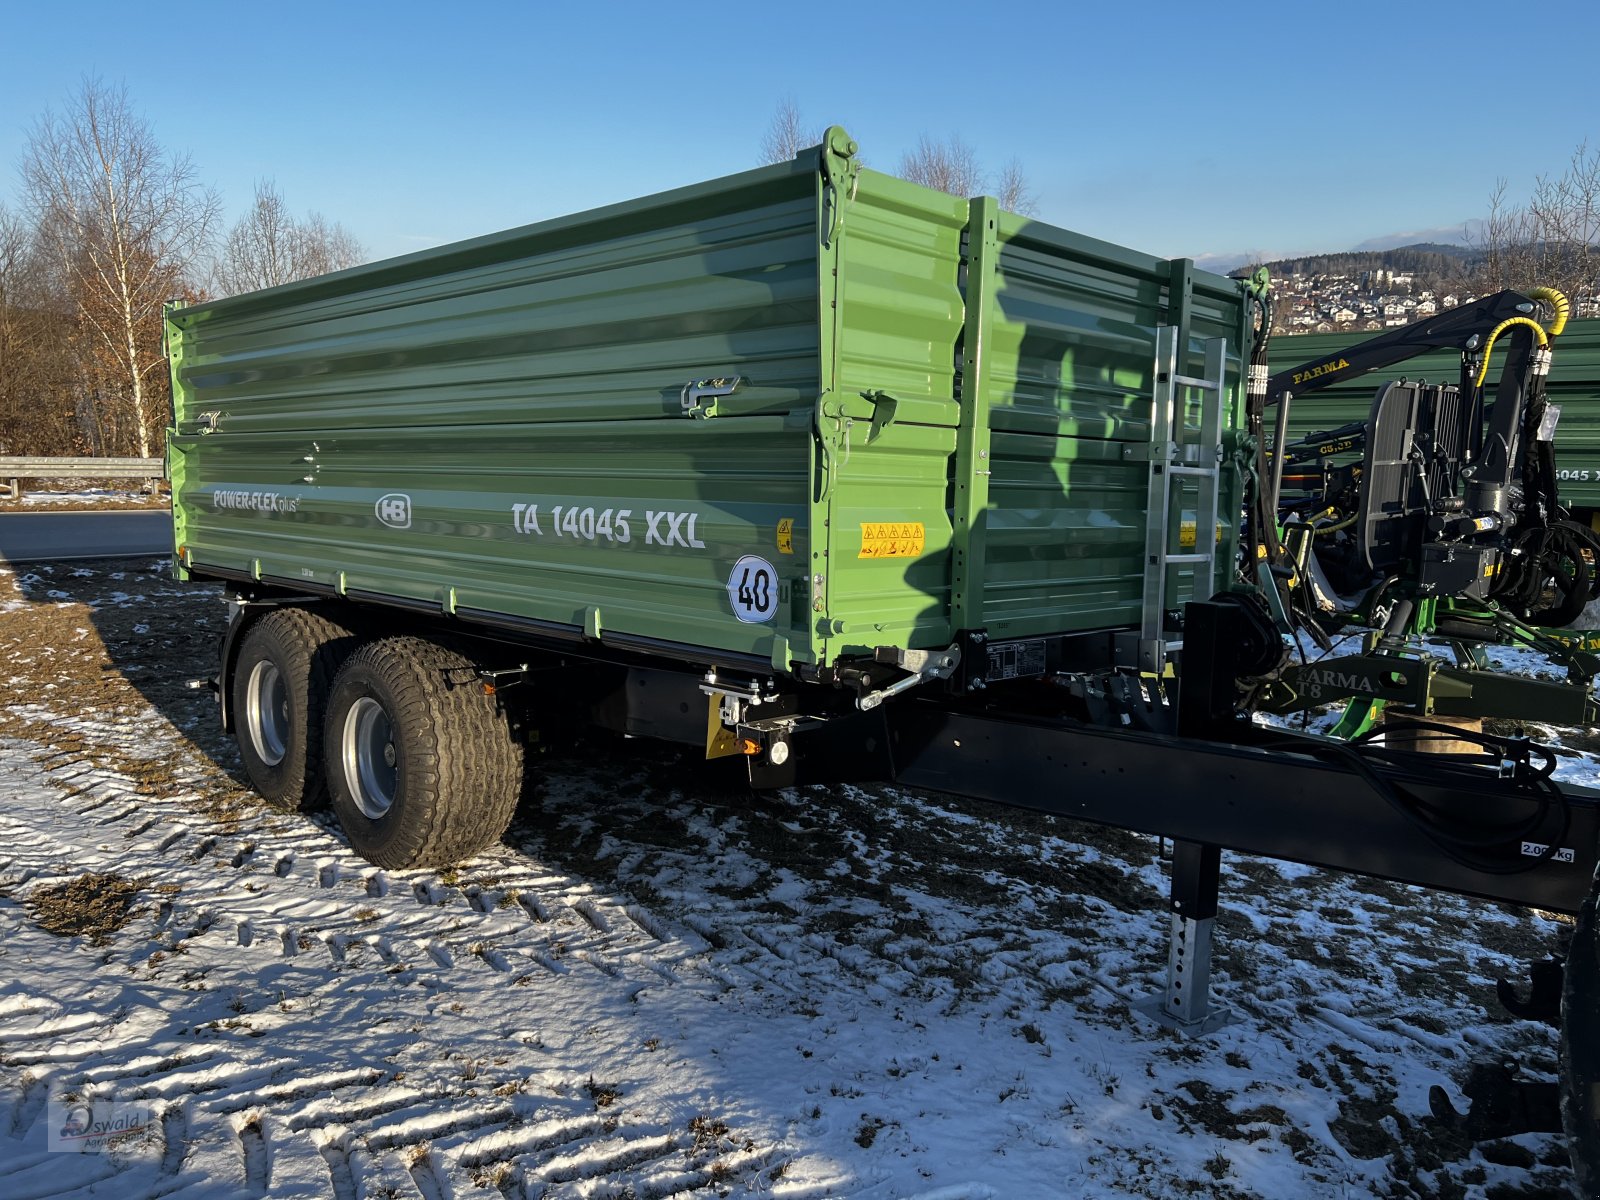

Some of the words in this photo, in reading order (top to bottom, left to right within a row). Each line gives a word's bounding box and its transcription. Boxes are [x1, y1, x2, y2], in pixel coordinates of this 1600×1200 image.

[1292, 358, 1350, 384] FARMA
[511, 503, 543, 536] TA
[551, 505, 632, 543] 14045
[645, 510, 706, 549] XXL
[738, 567, 770, 613] 40
[1295, 680, 1322, 699] T8
[1296, 667, 1374, 693] FARMA
